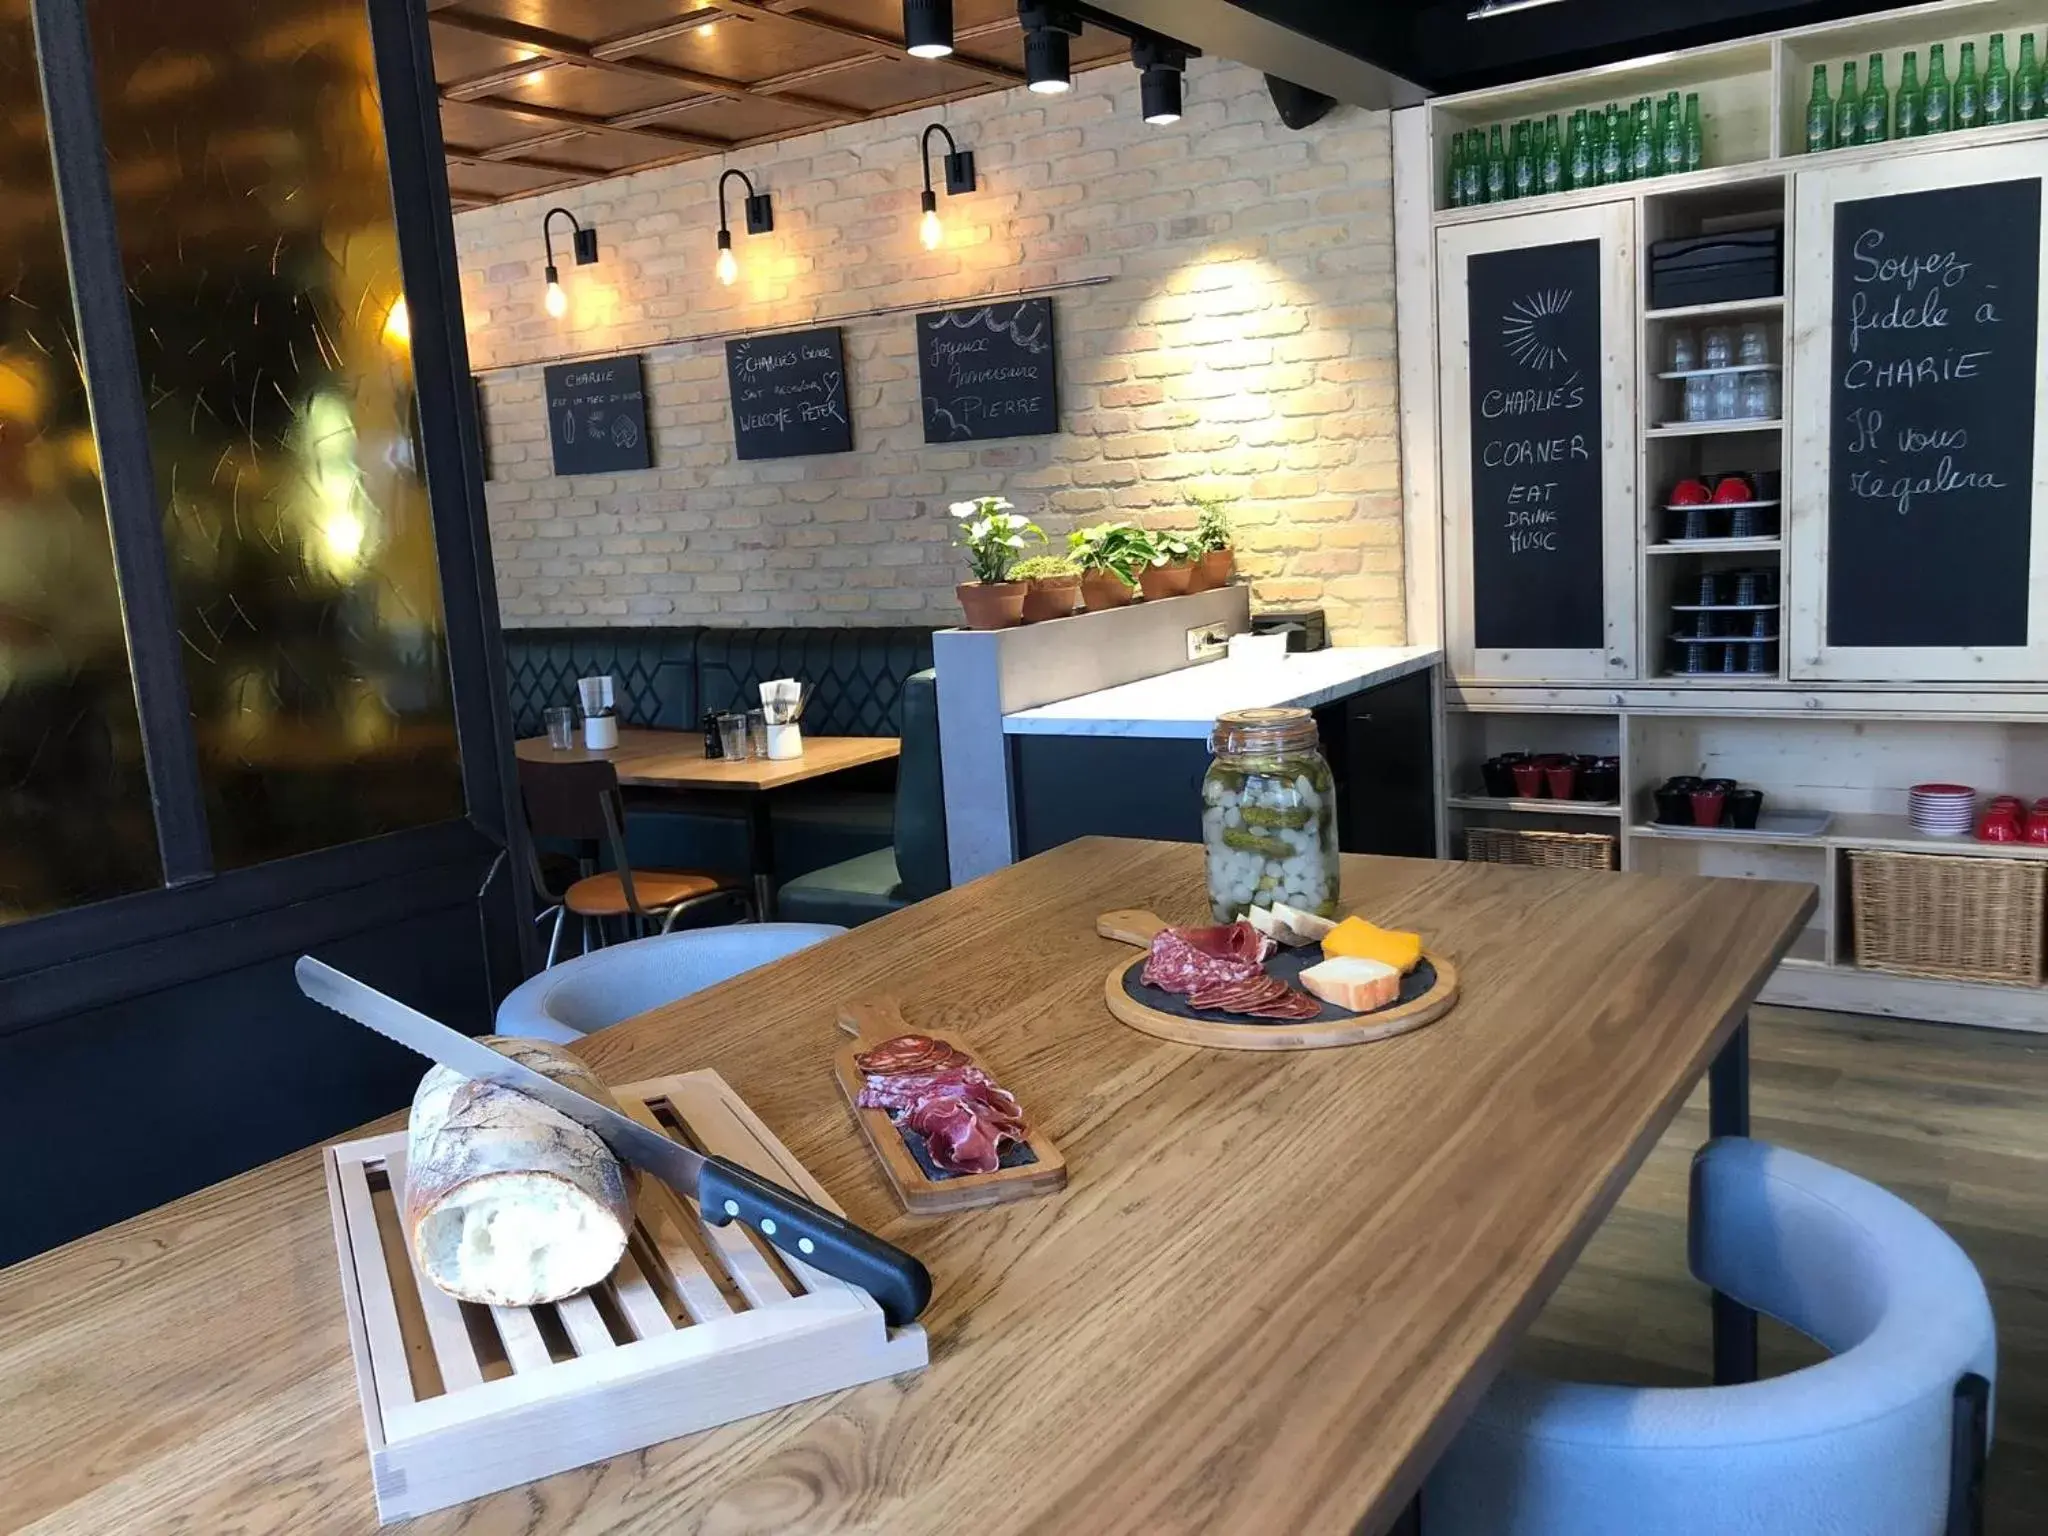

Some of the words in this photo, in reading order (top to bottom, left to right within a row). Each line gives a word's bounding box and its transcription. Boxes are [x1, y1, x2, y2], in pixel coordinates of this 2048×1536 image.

[1853, 229, 1973, 291] Soyez
[1975, 284, 2003, 324] à
[928, 336, 989, 367] Joyeux
[565, 370, 614, 388] CHARLIE
[948, 362, 1038, 389] Anniversaire
[739, 407, 793, 433] WELCOME
[797, 399, 846, 424] PETER
[950, 395, 1042, 424] PIERRE
[1847, 407, 1882, 453] Il
[1899, 427, 1967, 452] vous
[1483, 435, 1589, 467] CORNER
[1508, 483, 1559, 504] EAT
[1504, 509, 1557, 528] DRINK
[1510, 531, 1557, 554] MUSIC
